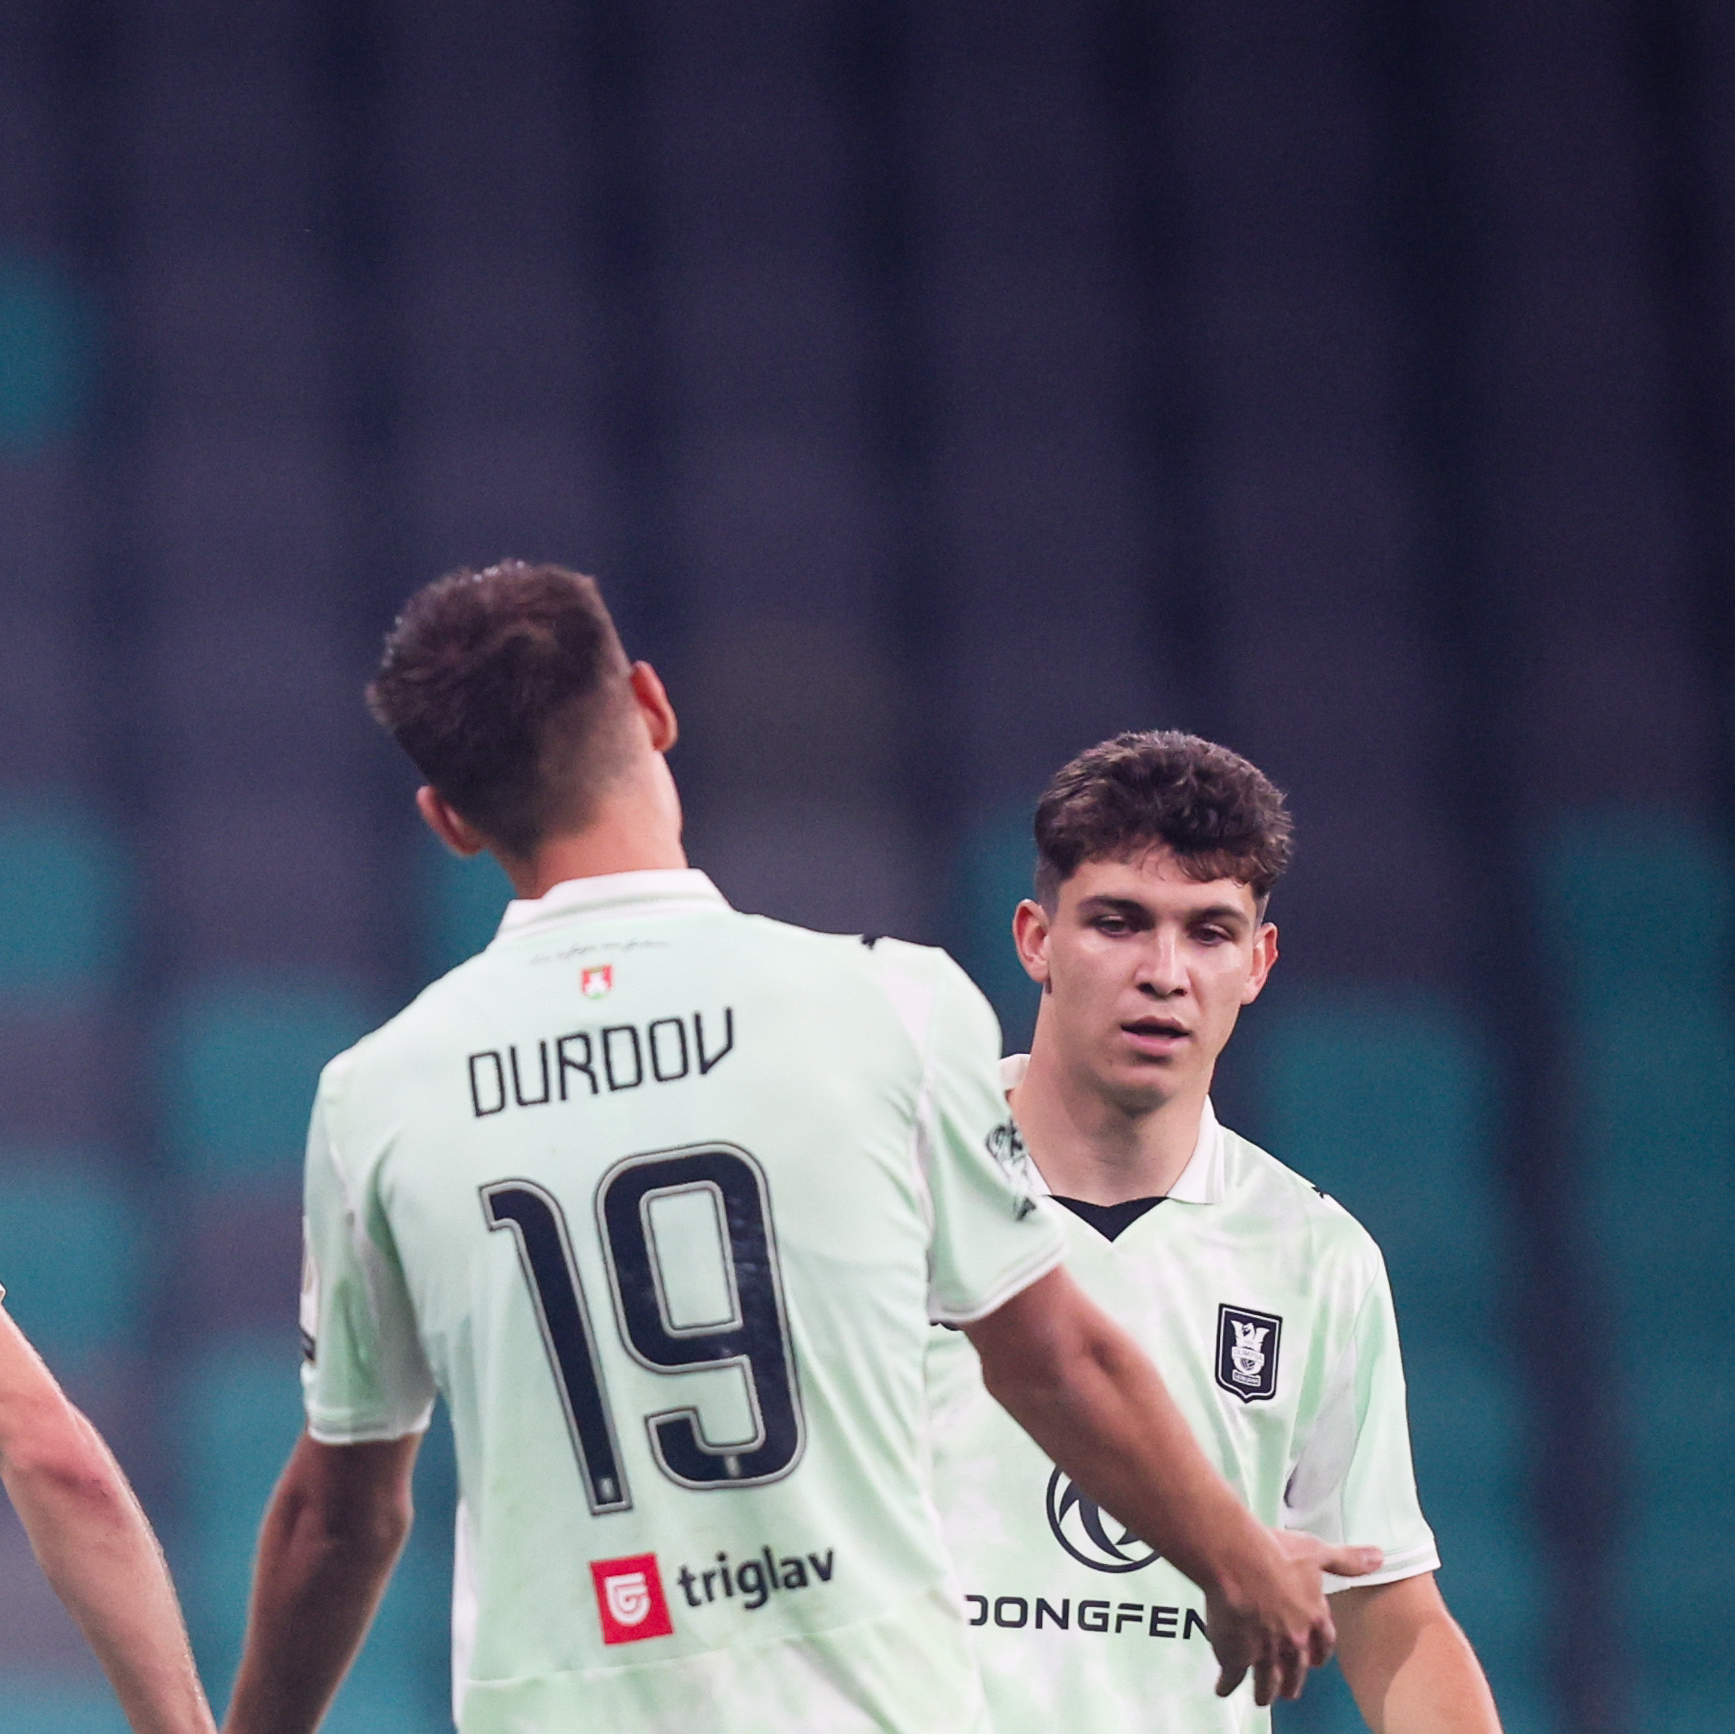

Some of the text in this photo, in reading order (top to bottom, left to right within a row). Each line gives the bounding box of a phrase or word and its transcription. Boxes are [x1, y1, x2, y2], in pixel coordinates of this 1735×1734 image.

[468, 1005, 734, 1119] DURDOV
[479, 1140, 808, 1515] 19
[676, 1544, 835, 1610] triglav
[963, 1594, 1212, 1643] DONGFEN
